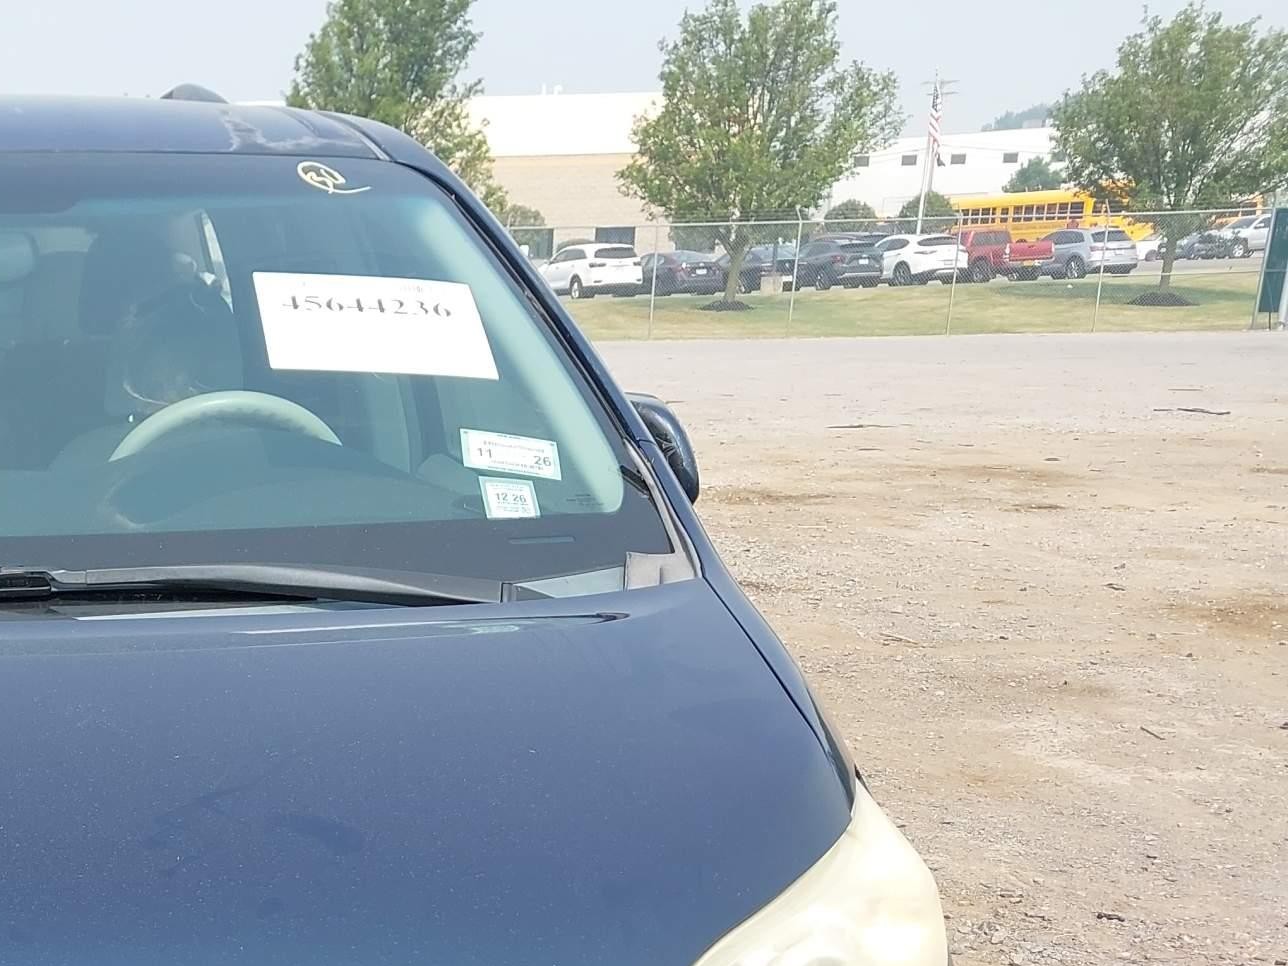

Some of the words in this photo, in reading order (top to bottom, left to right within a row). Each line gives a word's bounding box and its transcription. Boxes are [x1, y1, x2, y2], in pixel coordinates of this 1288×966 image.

[282, 295, 452, 317] 45644236
[533, 455, 552, 467] 26
[495, 492, 509, 502] 12
[512, 493, 528, 504] 26
